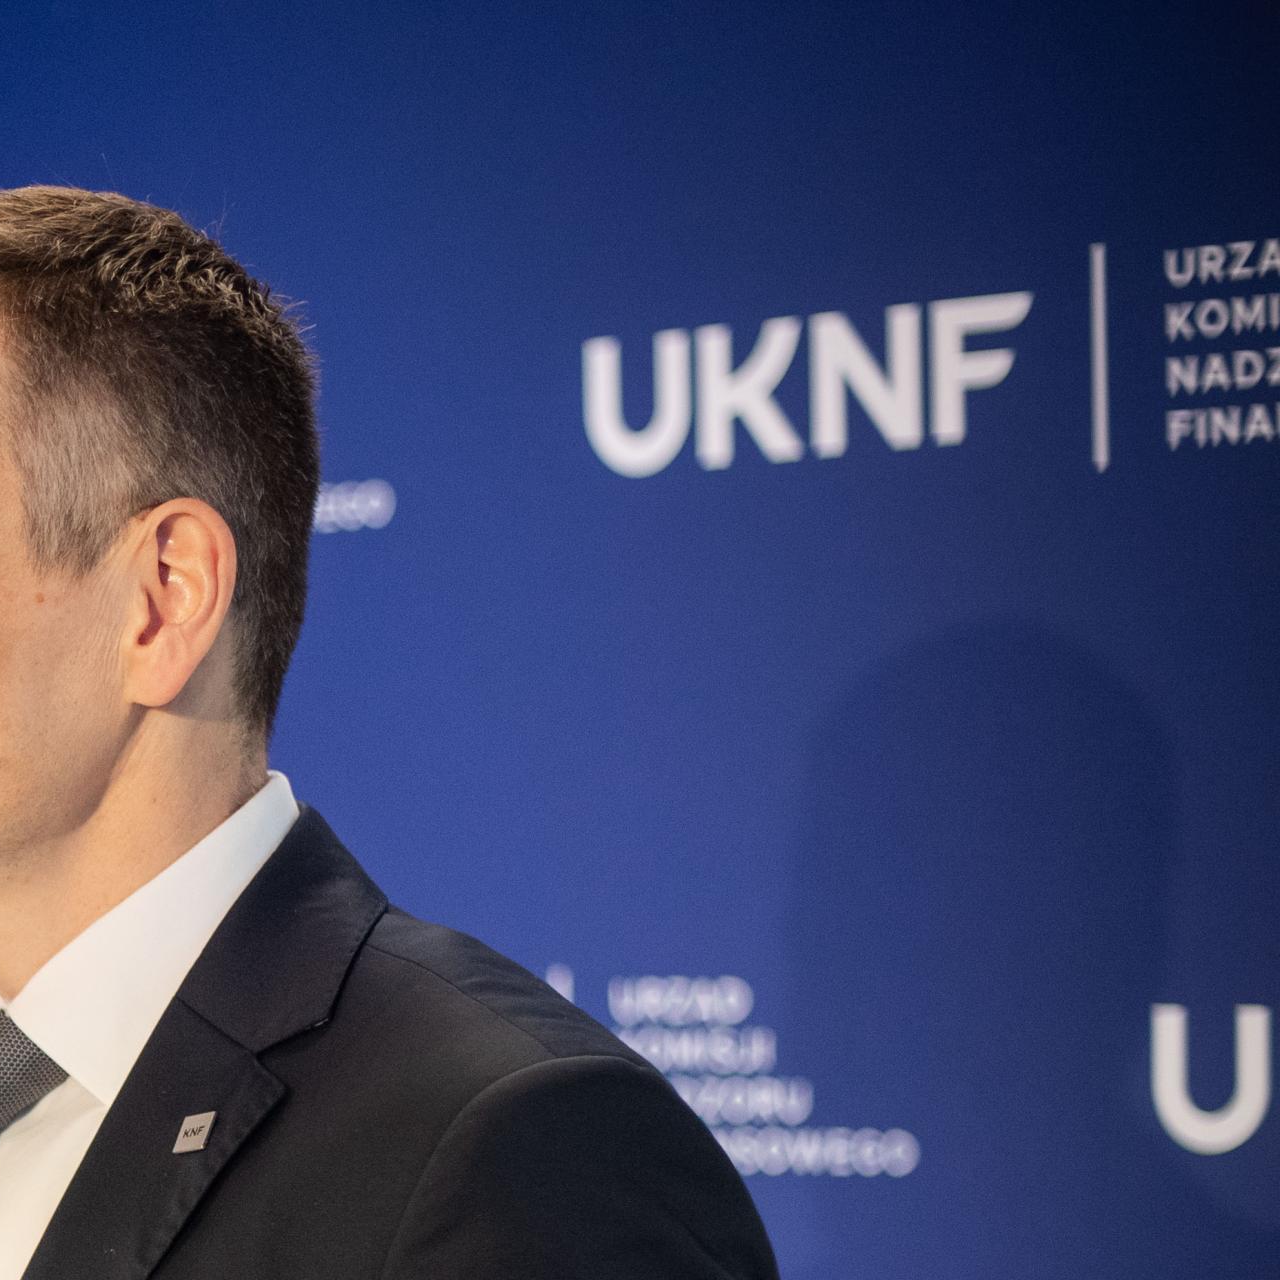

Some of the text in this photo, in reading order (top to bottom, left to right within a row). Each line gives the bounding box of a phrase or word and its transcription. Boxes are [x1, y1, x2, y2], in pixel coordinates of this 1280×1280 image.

[581, 290, 1034, 479] UKNF
[1166, 402, 1280, 451] FINA
[1150, 1003, 1272, 1155] U
[183, 1125, 205, 1139] KNF
